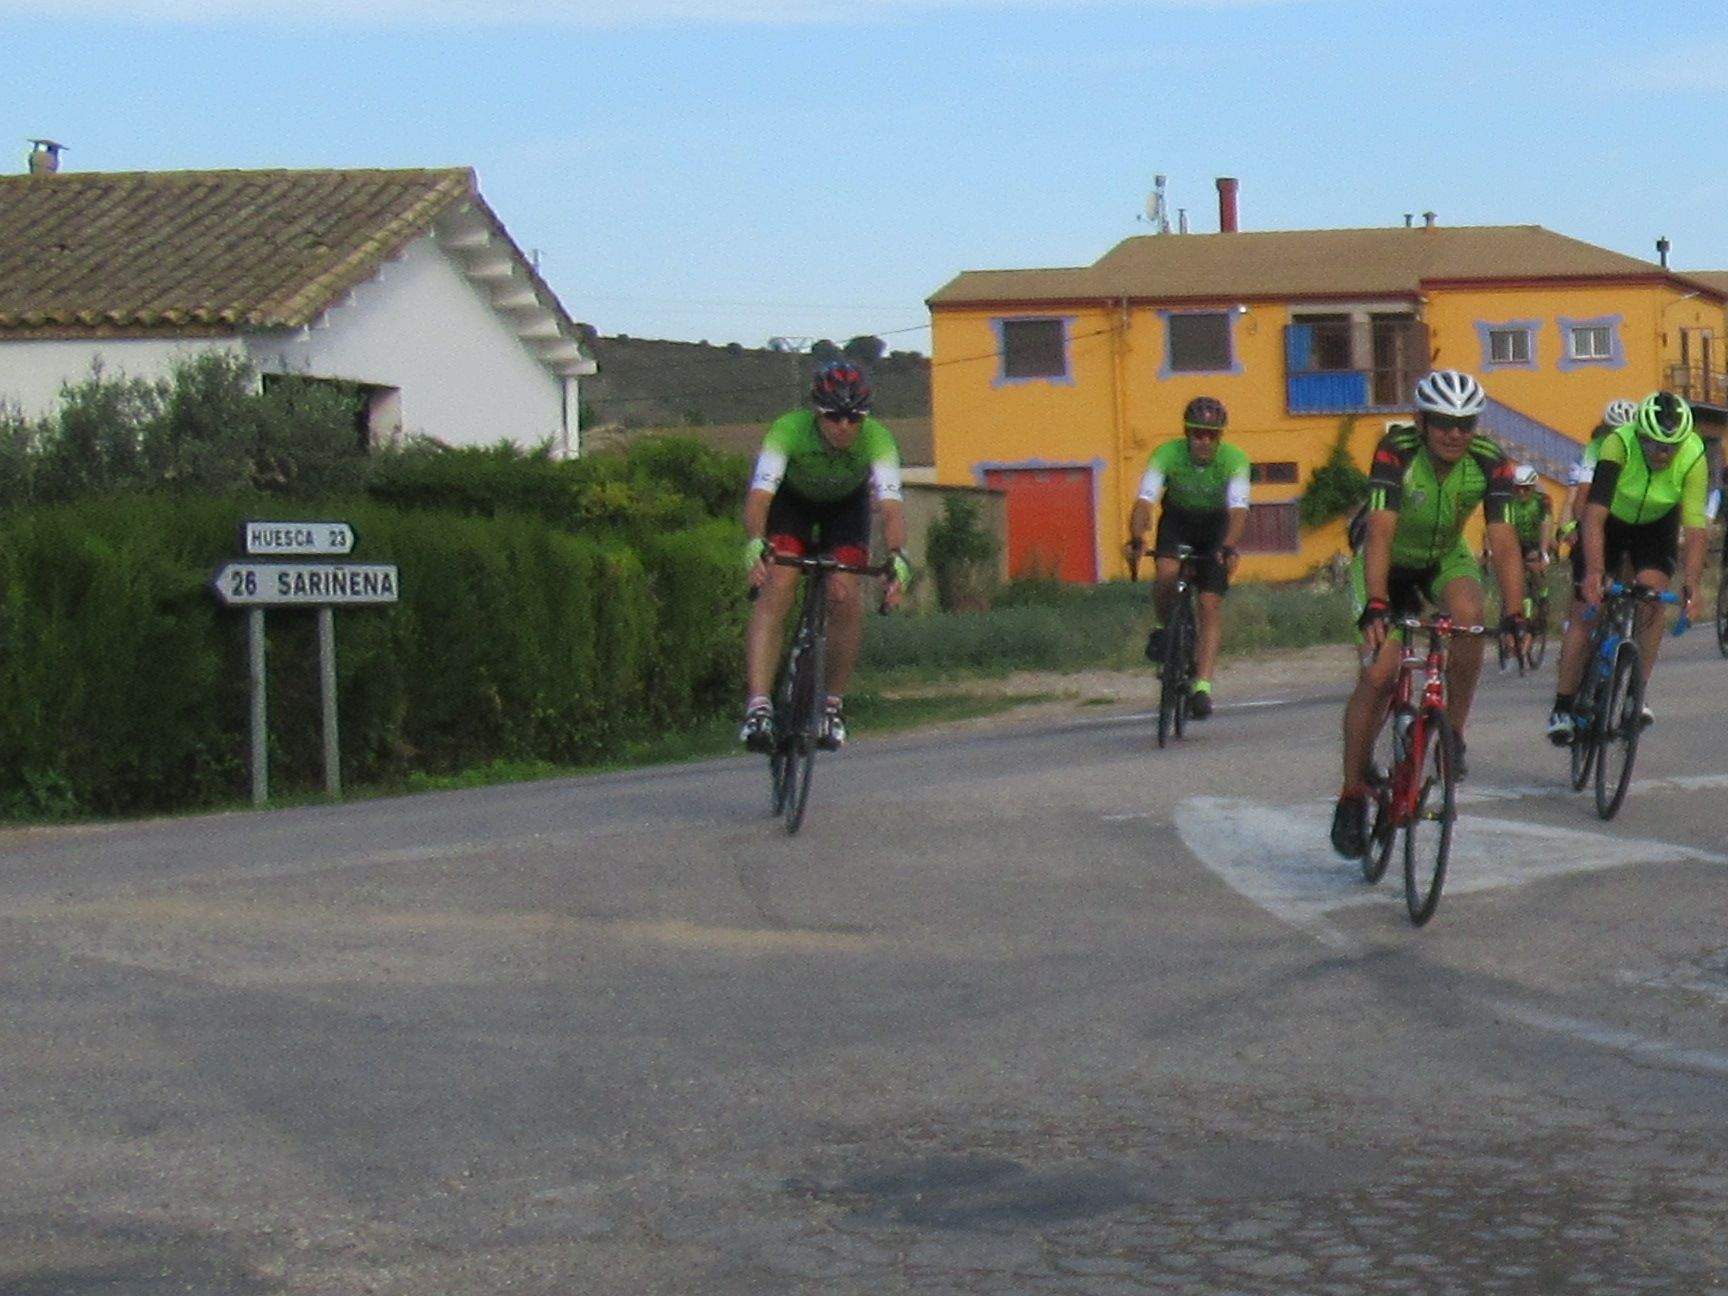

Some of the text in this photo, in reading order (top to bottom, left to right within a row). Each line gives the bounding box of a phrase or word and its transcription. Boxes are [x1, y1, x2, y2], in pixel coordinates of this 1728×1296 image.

[252, 530, 347, 547] HUESCA 23
[231, 567, 394, 596] 26 SARIÑENA
